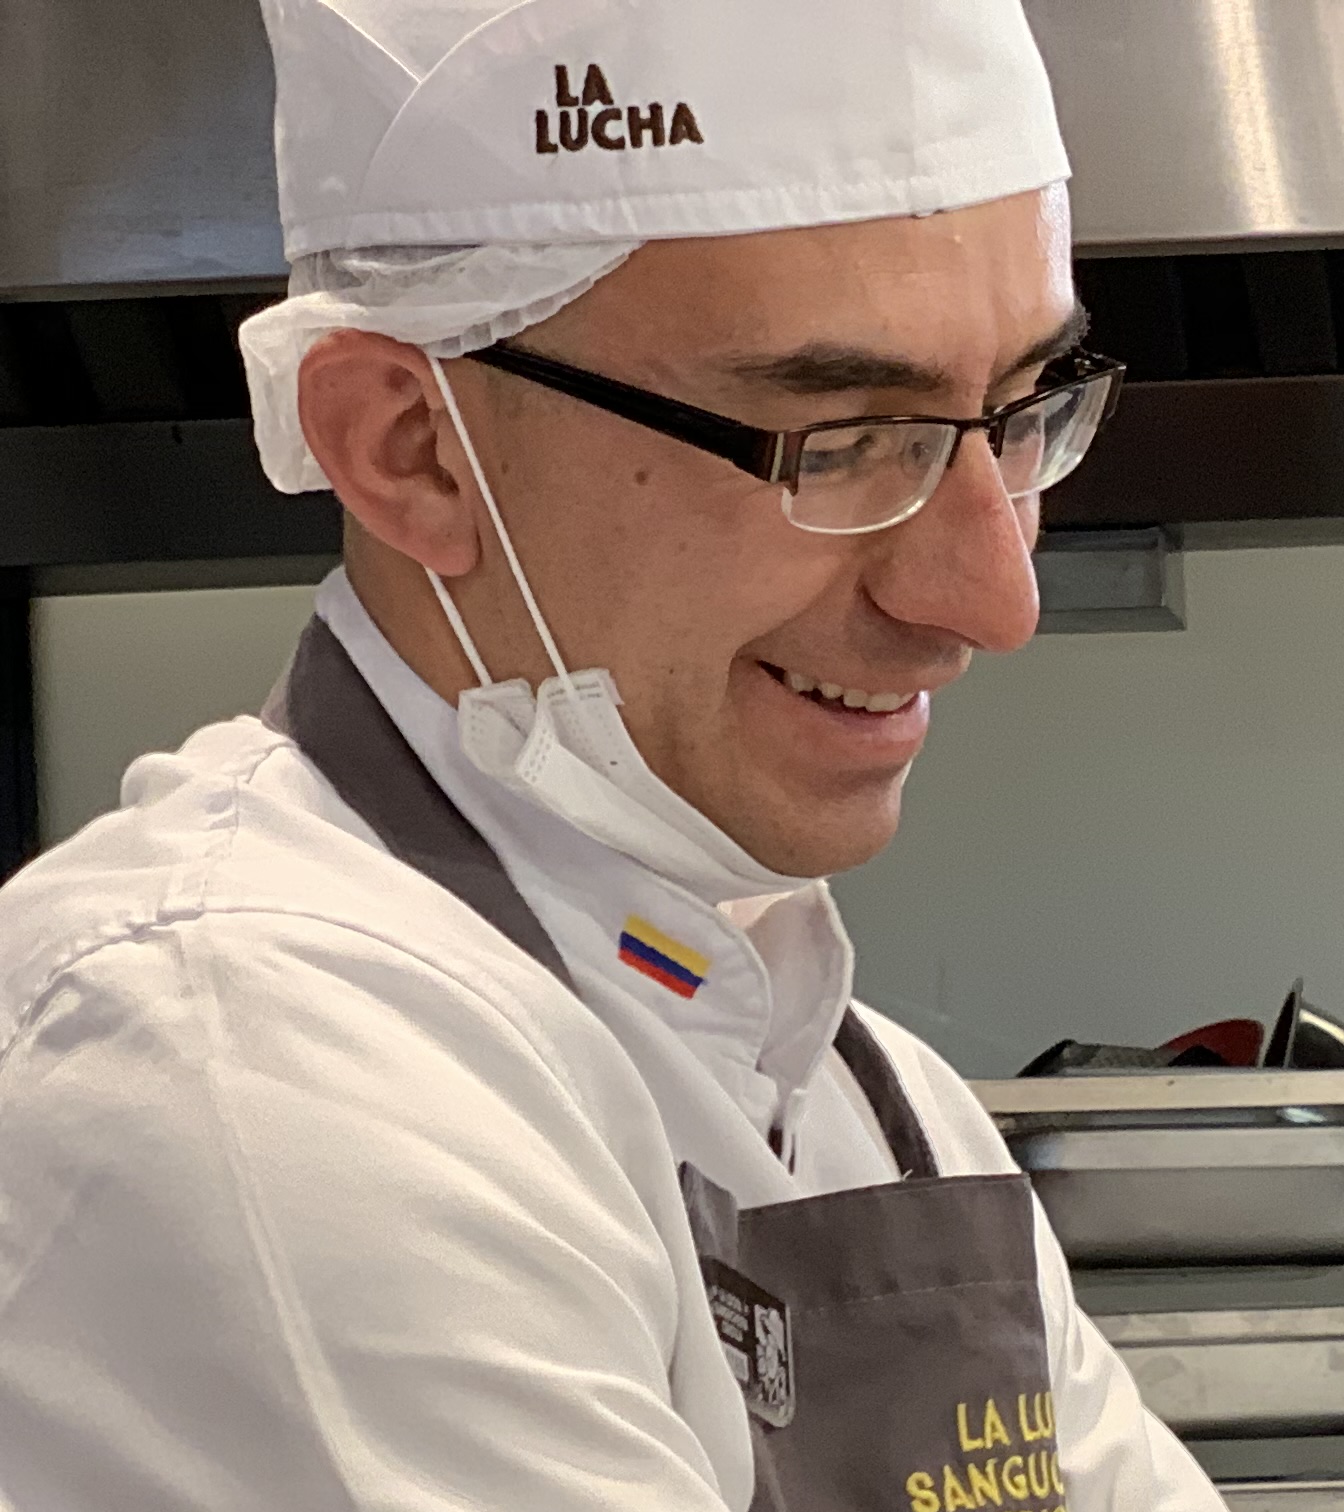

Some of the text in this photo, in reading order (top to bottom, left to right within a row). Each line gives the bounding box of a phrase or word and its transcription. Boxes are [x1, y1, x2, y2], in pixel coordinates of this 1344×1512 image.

[554, 63, 615, 107] LA
[534, 101, 705, 154] LUCHA
[956, 1398, 1012, 1453] LA
